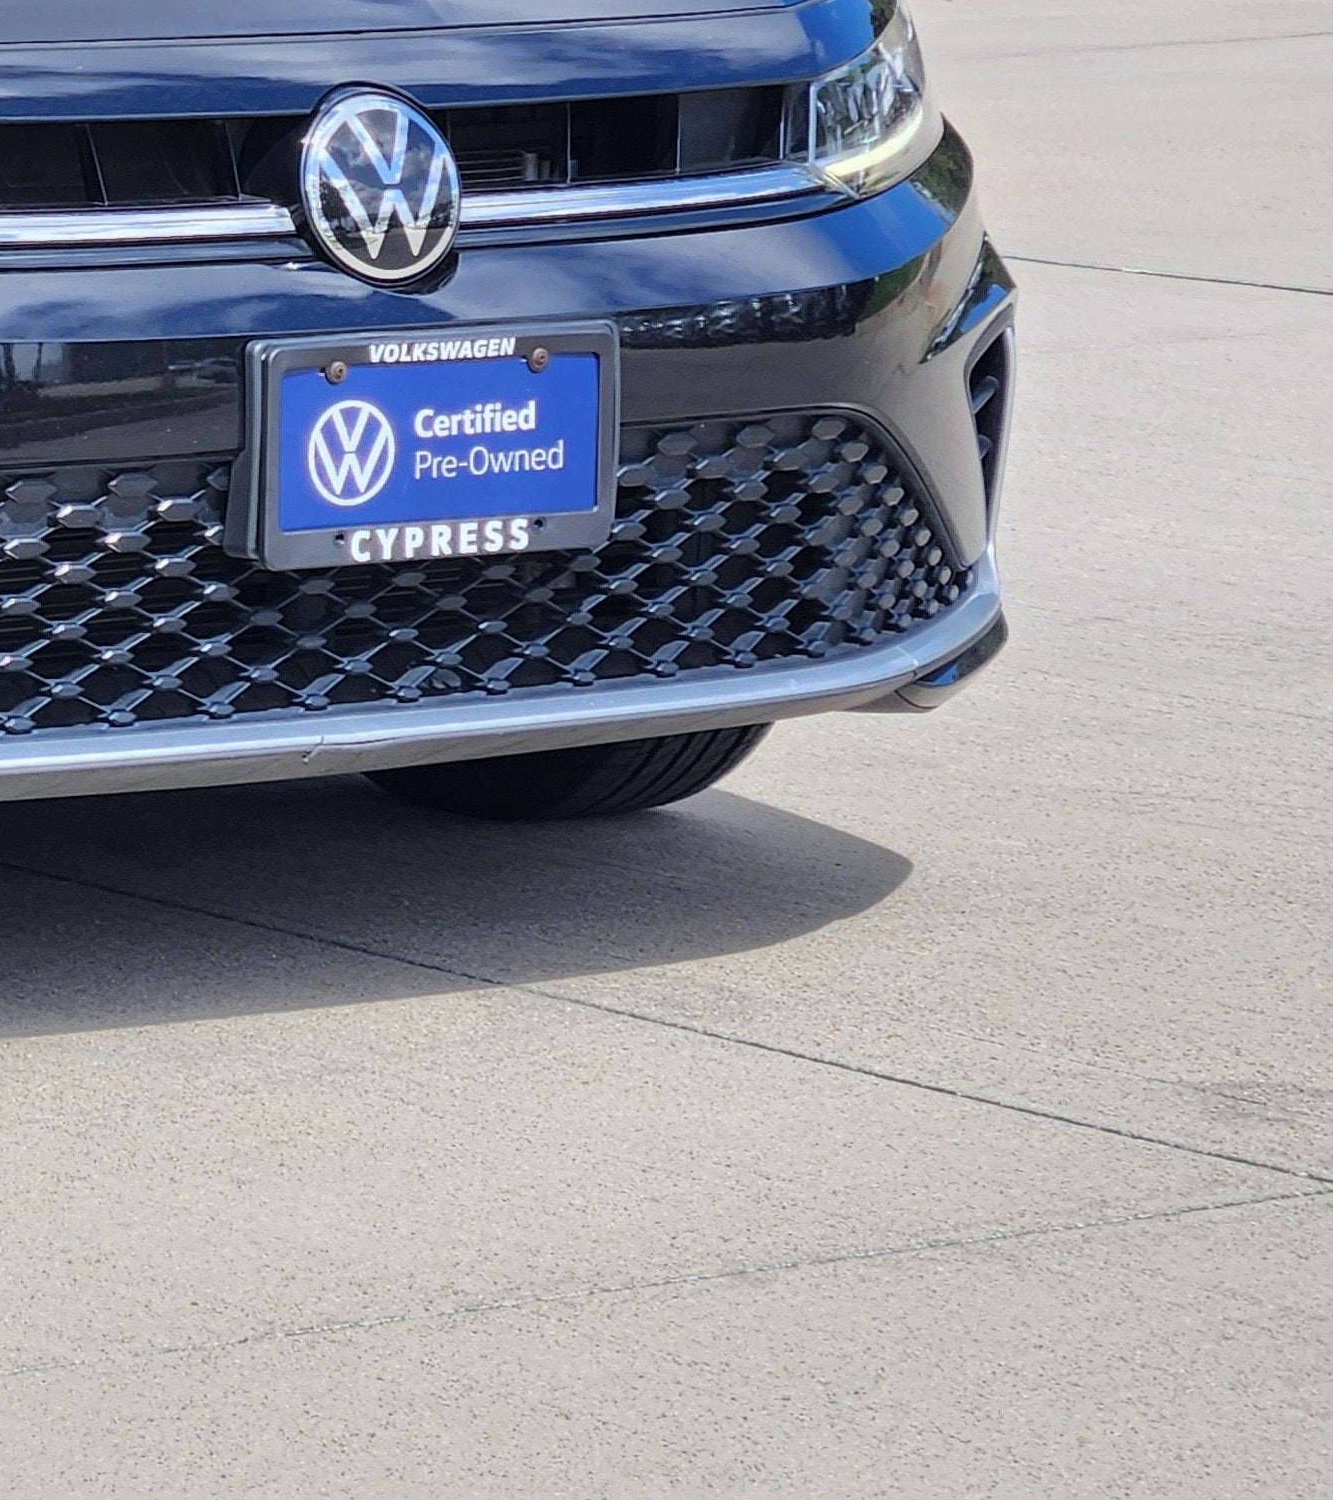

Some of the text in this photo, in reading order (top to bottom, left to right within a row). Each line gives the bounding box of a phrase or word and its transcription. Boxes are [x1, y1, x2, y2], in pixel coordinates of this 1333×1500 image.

[368, 337, 517, 365] VOLKSWAGEN
[414, 401, 537, 438] Certified
[414, 440, 565, 480] Pre-Owned
[349, 518, 531, 563] CYPRESS
